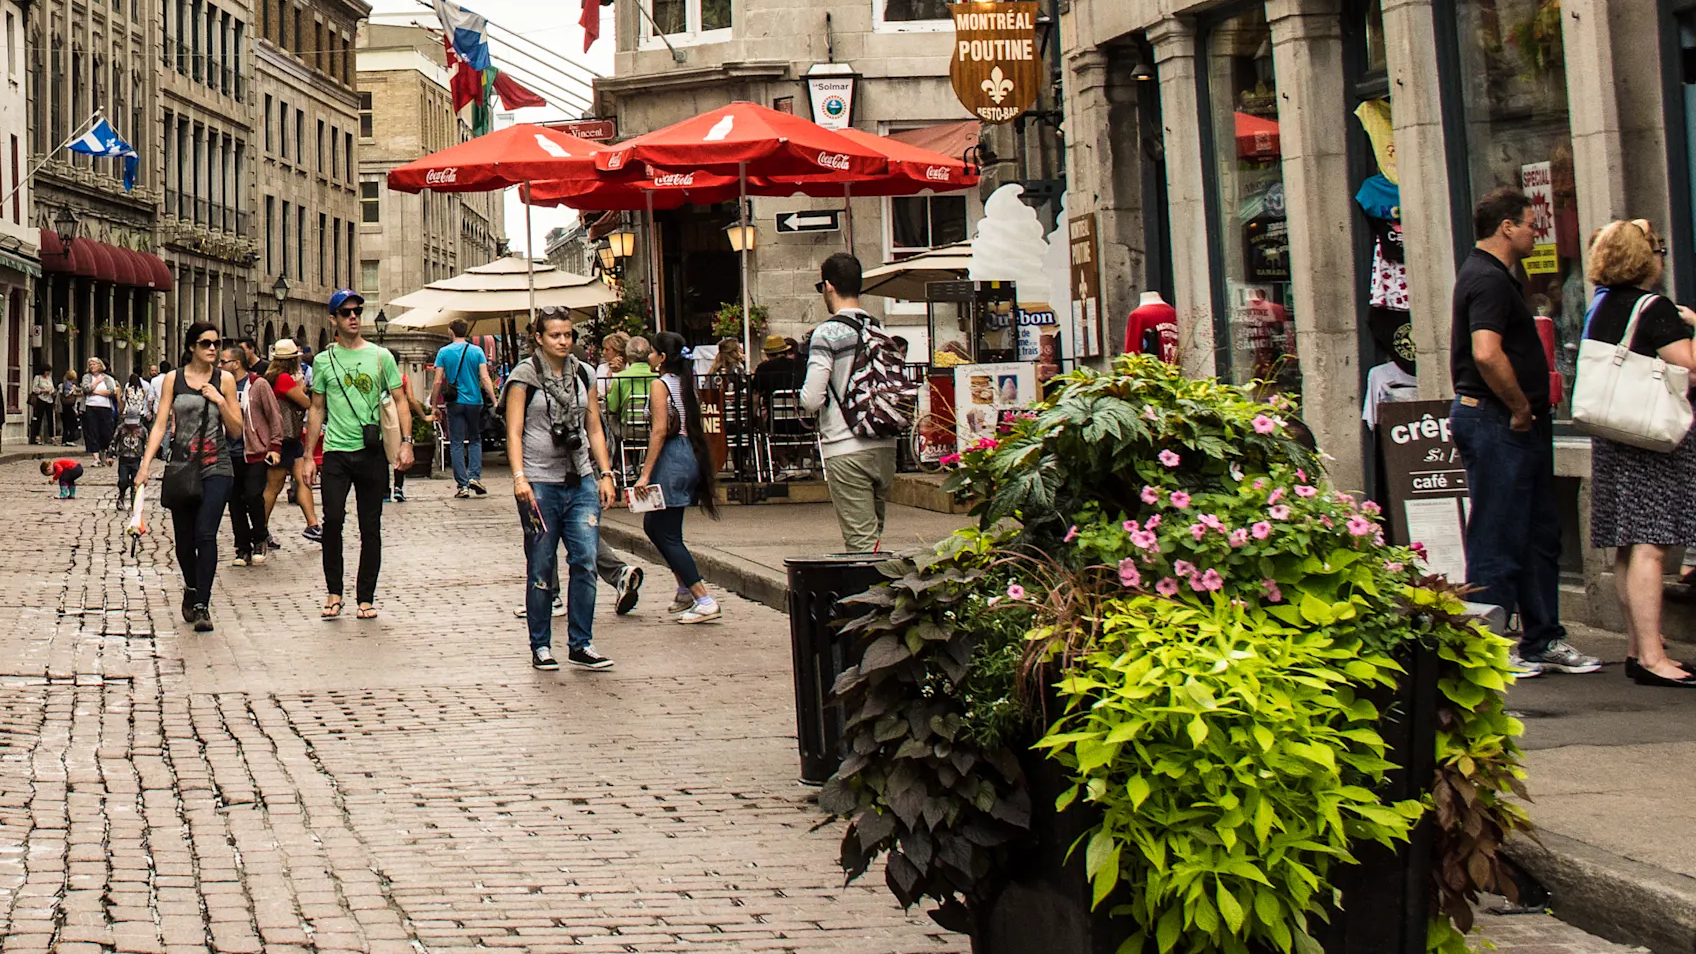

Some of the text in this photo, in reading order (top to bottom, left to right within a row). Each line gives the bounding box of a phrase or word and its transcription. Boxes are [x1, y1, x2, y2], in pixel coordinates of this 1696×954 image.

[956, 9, 1034, 30] MONTRÉAL
[958, 39, 1034, 62] POUTINE
[818, 82, 849, 91] Solmar
[976, 106, 1020, 122] RESTO-BAR
[1021, 348, 1039, 357] frais
[1413, 473, 1449, 489] café
